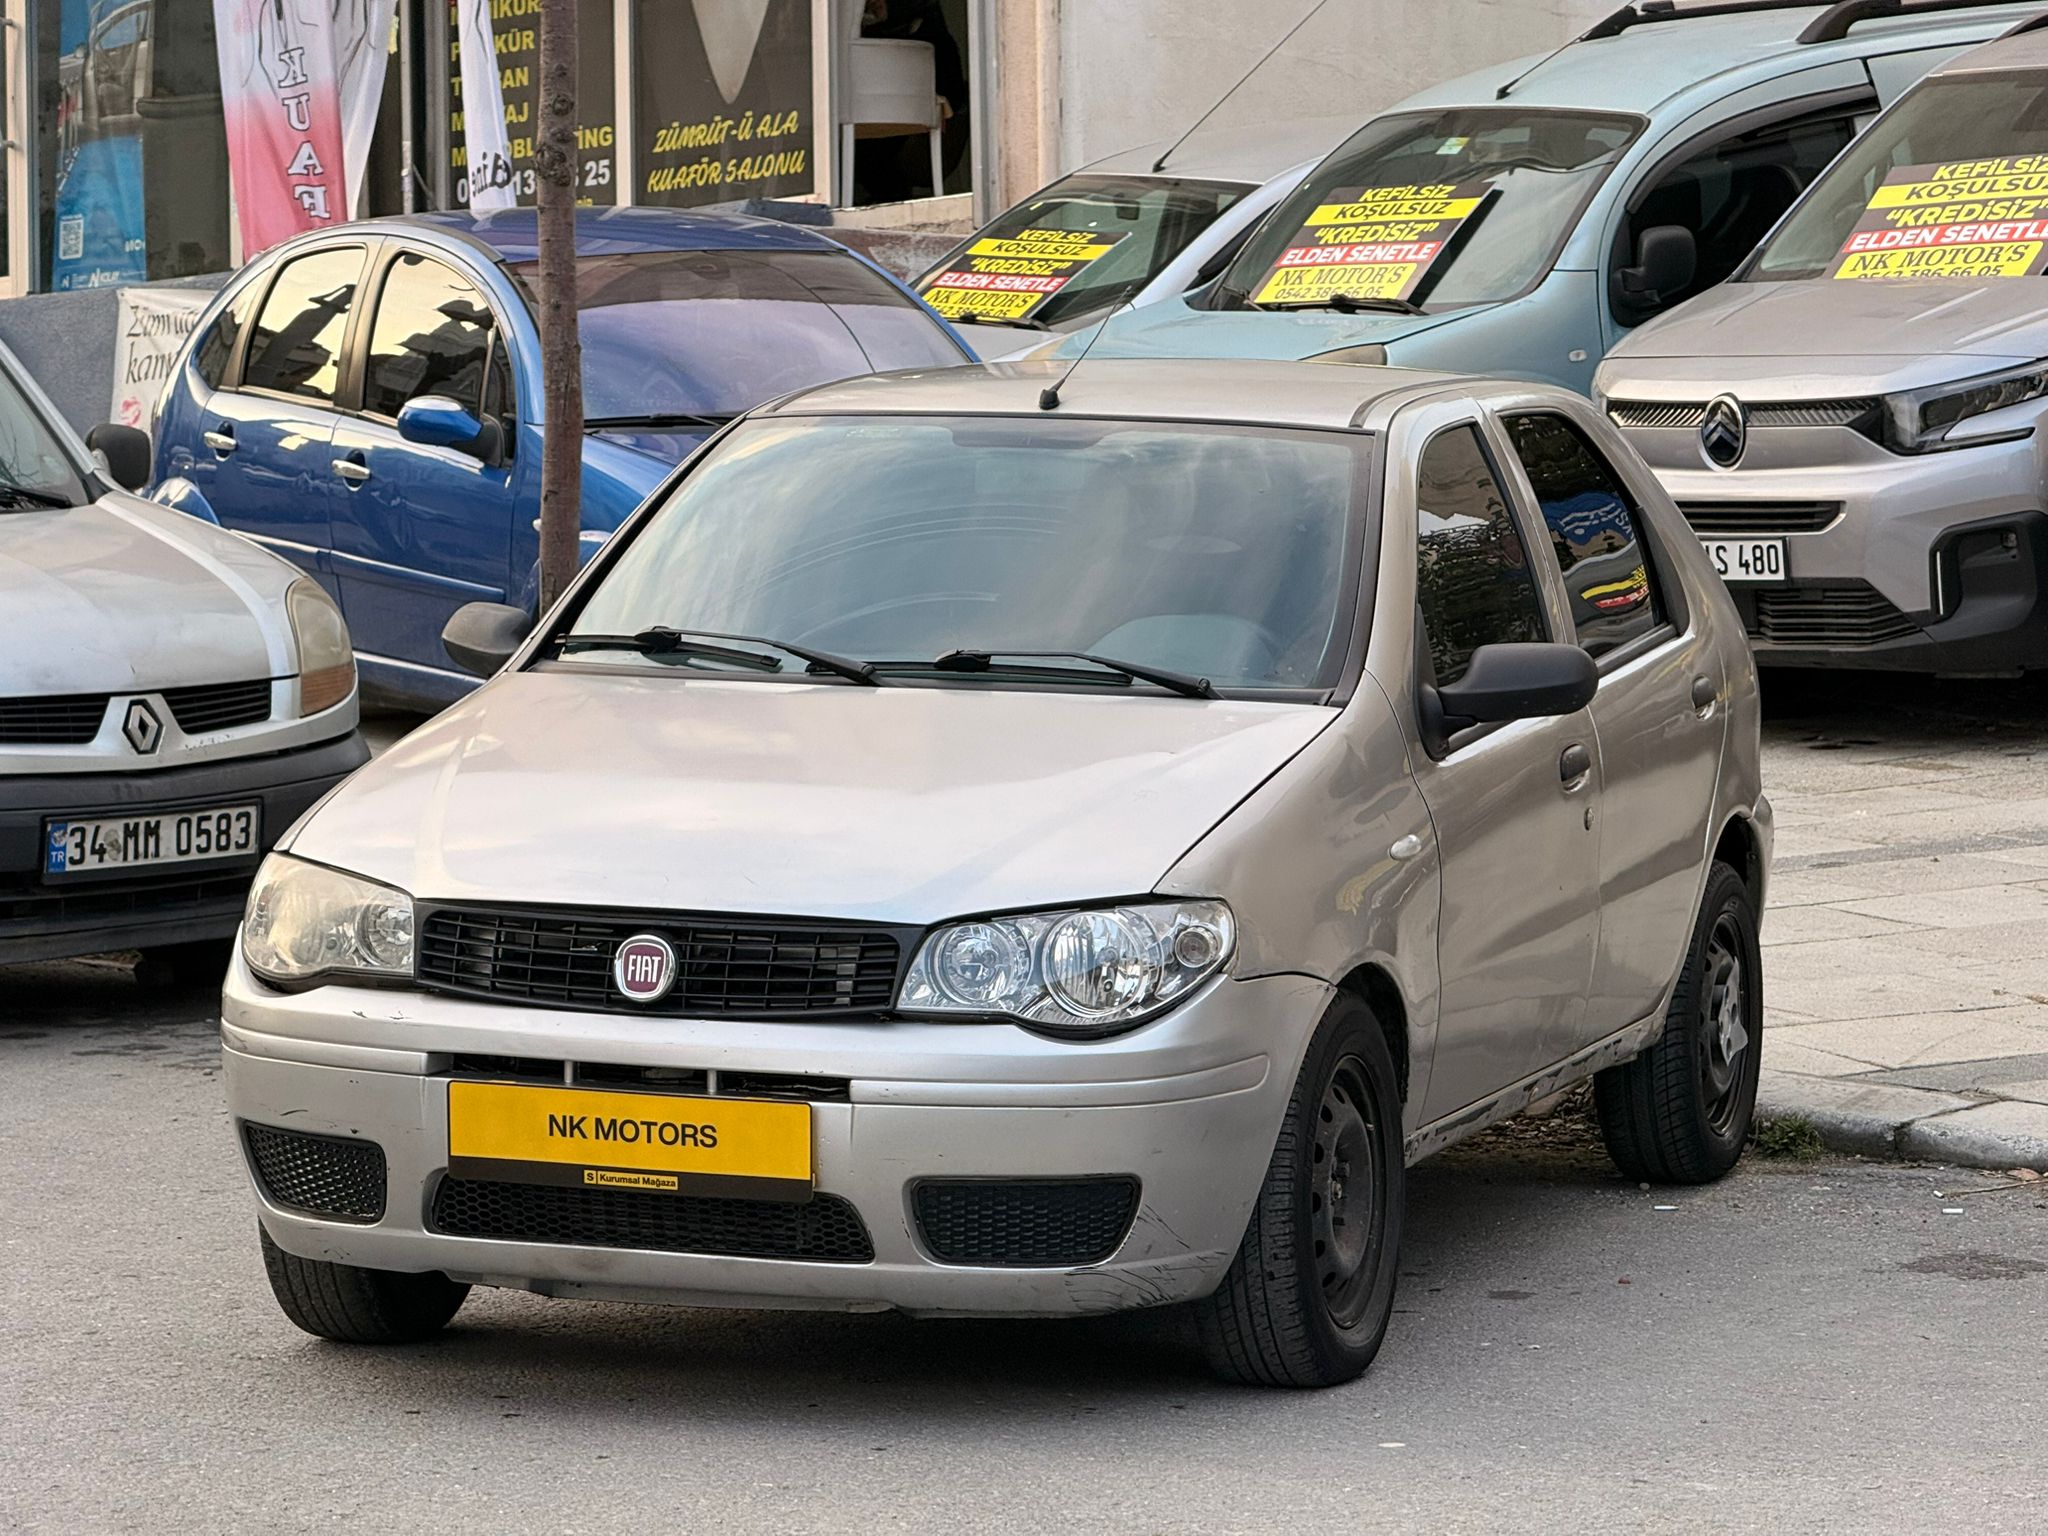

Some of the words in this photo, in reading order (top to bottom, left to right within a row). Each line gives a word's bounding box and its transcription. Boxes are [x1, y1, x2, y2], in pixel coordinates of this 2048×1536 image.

[451, 29, 534, 61] PKÜR
[652, 111, 753, 153] ZÜMRÜT-Ü
[756, 110, 799, 139] ALA
[584, 159, 610, 187] 25
[647, 157, 723, 193] KUAFÖR
[725, 150, 806, 183] SALONU
[1358, 184, 1457, 202] KEFİLSİZ
[1333, 201, 1452, 220] KOŞULSUZ
[1015, 229, 1098, 244] KEFİLSİZ
[1849, 229, 1934, 251] ELDEN
[991, 241, 1090, 256] KOŞULSUZ
[1280, 246, 1348, 265] ELDEN
[1345, 242, 1436, 262] SENETLE
[1849, 251, 1896, 272] NK
[1899, 244, 2031, 268] MOTOR'S
[938, 271, 998, 289] ELDEN
[991, 276, 1063, 292] SENETLE
[1275, 267, 1312, 286] NK
[1306, 265, 1408, 285] MOTOR'S
[1947, 266, 1975, 277] 66
[1976, 265, 2005, 276] 05
[928, 289, 959, 304] NK
[1274, 287, 1312, 300] 0542
[1363, 286, 1385, 298] 05
[1738, 544, 1780, 575] 480
[68, 826, 107, 865] 34
[122, 820, 161, 862] MM
[176, 811, 252, 856] 0583
[51, 850, 65, 863] TR
[627, 955, 662, 983] FIAT
[548, 1113, 588, 1140] NK
[594, 1117, 718, 1149] MOTORS
[599, 1173, 640, 1184] Kurumsal
[642, 1176, 677, 1188] Mağaza
